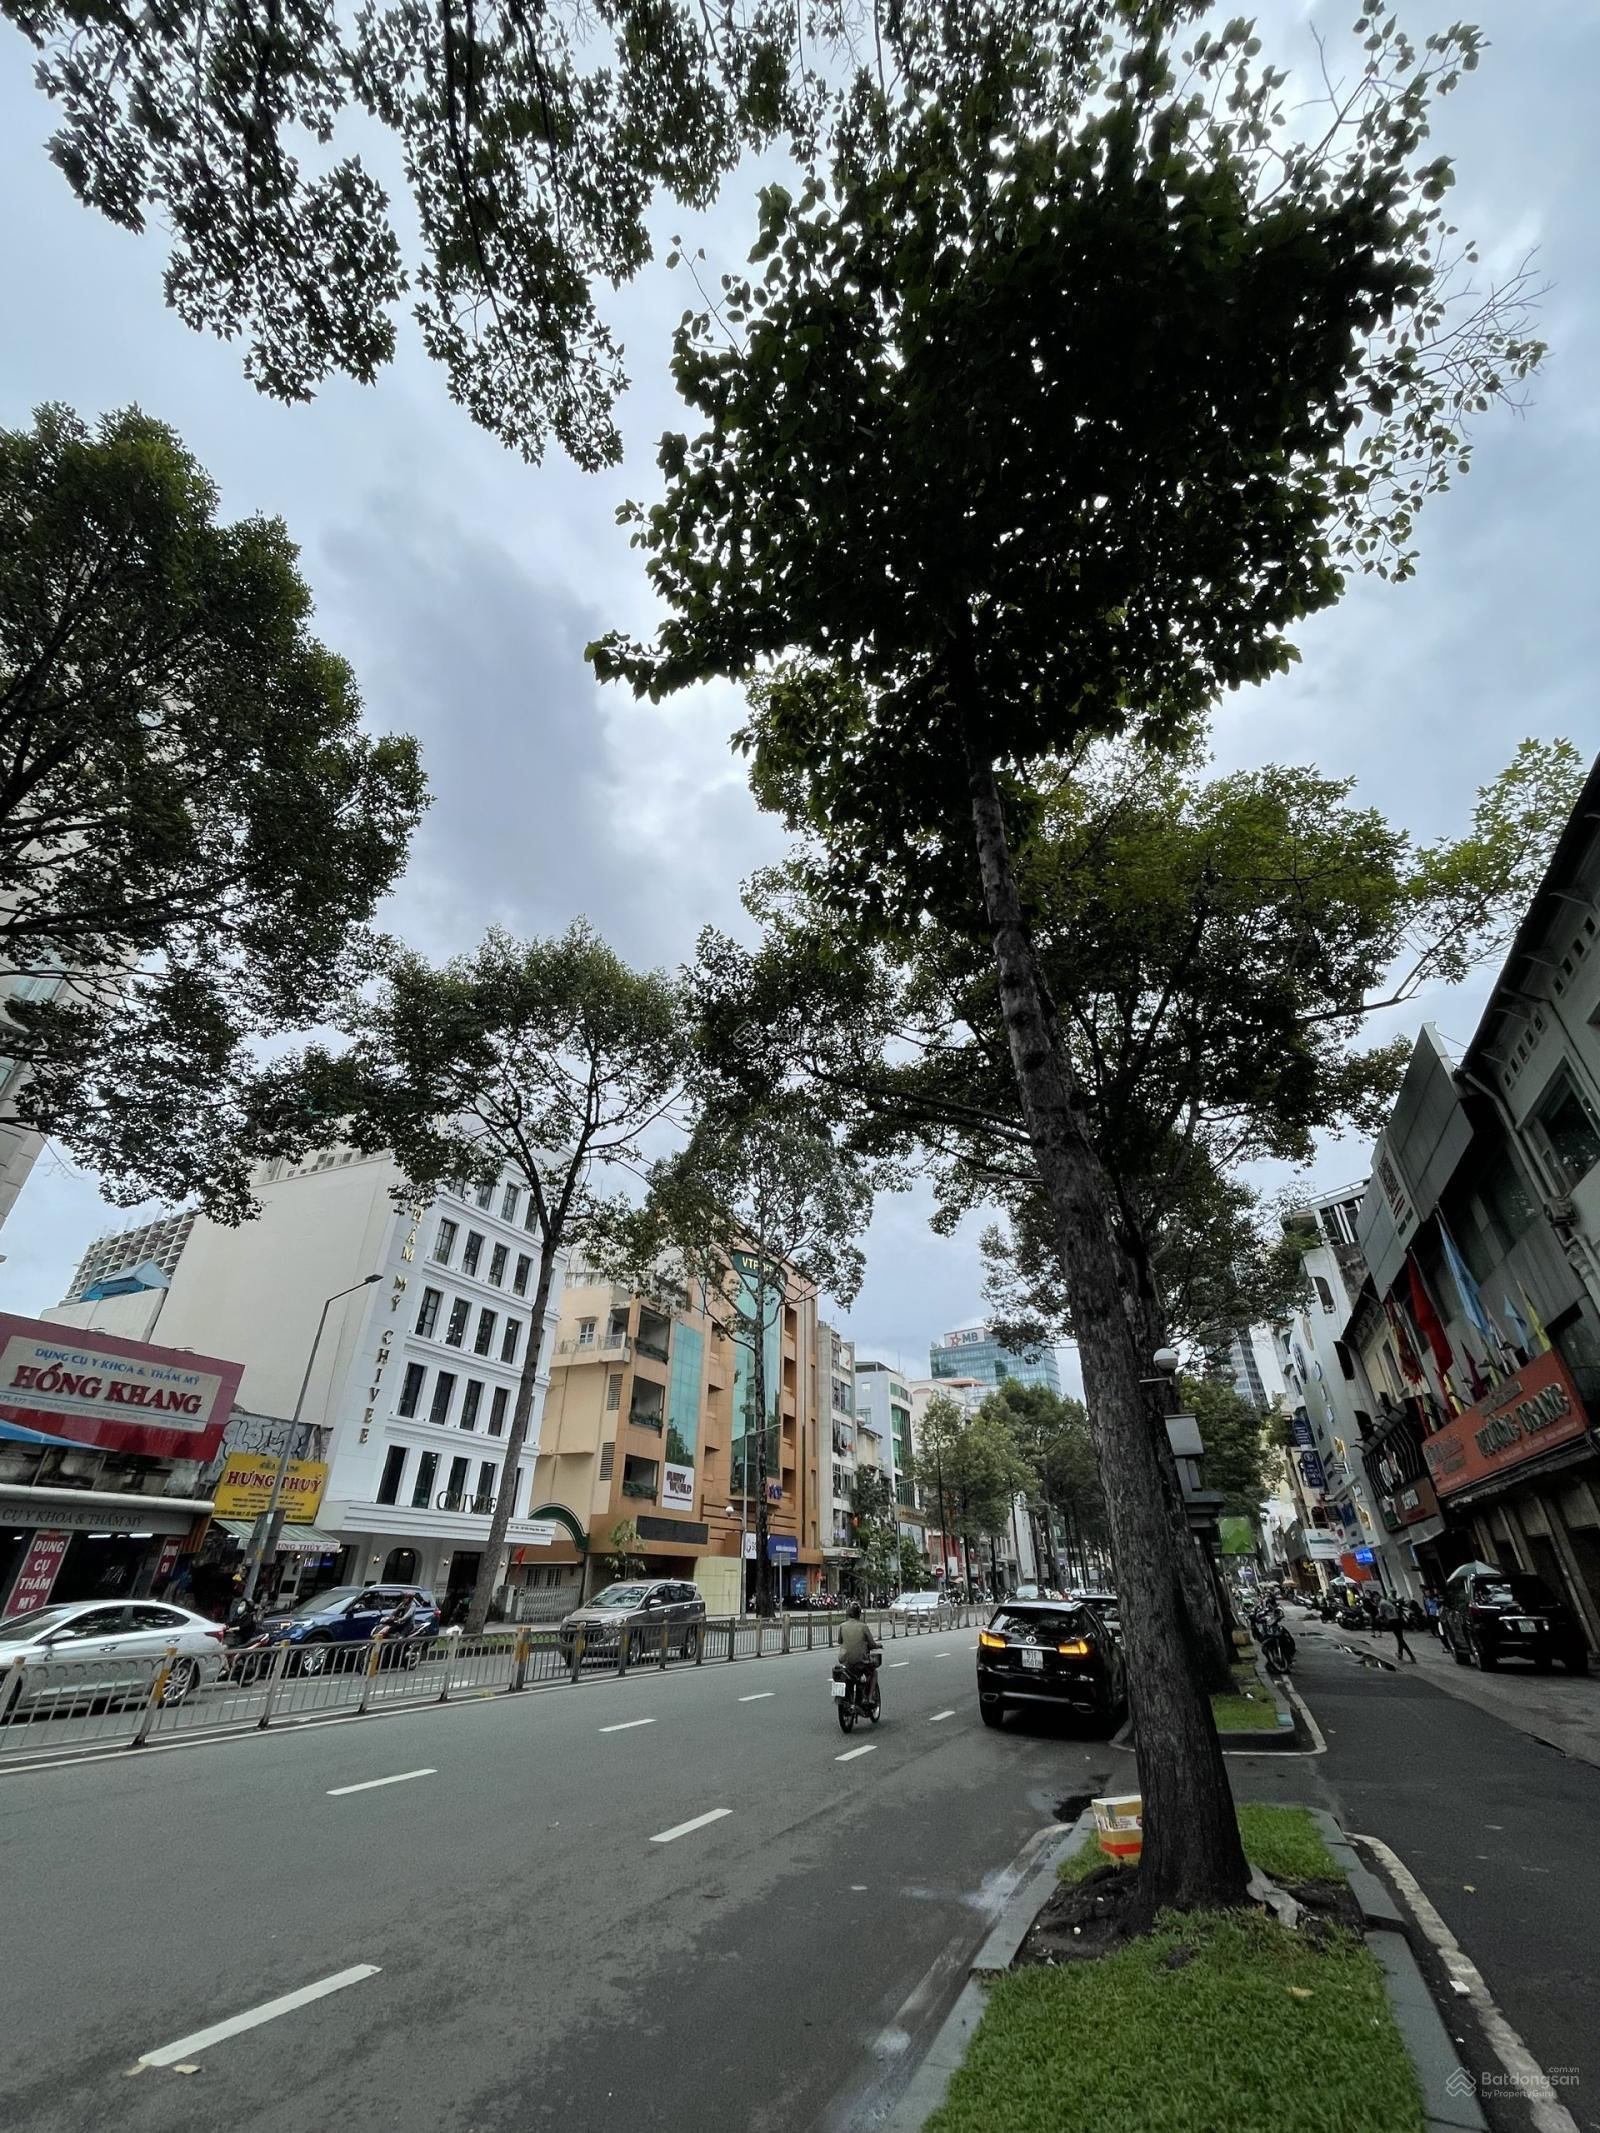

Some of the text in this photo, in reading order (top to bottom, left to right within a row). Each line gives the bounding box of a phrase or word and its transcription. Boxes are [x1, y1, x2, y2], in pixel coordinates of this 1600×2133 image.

[962, 1331, 978, 1343] MB
[35, 1348, 200, 1385] DỤNG CỤ Y KHOA & THẨM MỸ
[359, 1329, 394, 1445] CHIVEE
[104, 1380, 202, 1415] KHANG
[226, 1470, 275, 1488] HƯNG
[2, 1508, 22, 1520] CỤ
[24, 1510, 35, 1521] Y
[34, 1511, 73, 1524] KHOA
[75, 1514, 84, 1525] &
[34, 1541, 65, 1554] DỤNG
[34, 1559, 51, 1574] CỤ
[19, 1573, 52, 1590] THẨM
[17, 1596, 37, 1610] MỸ
